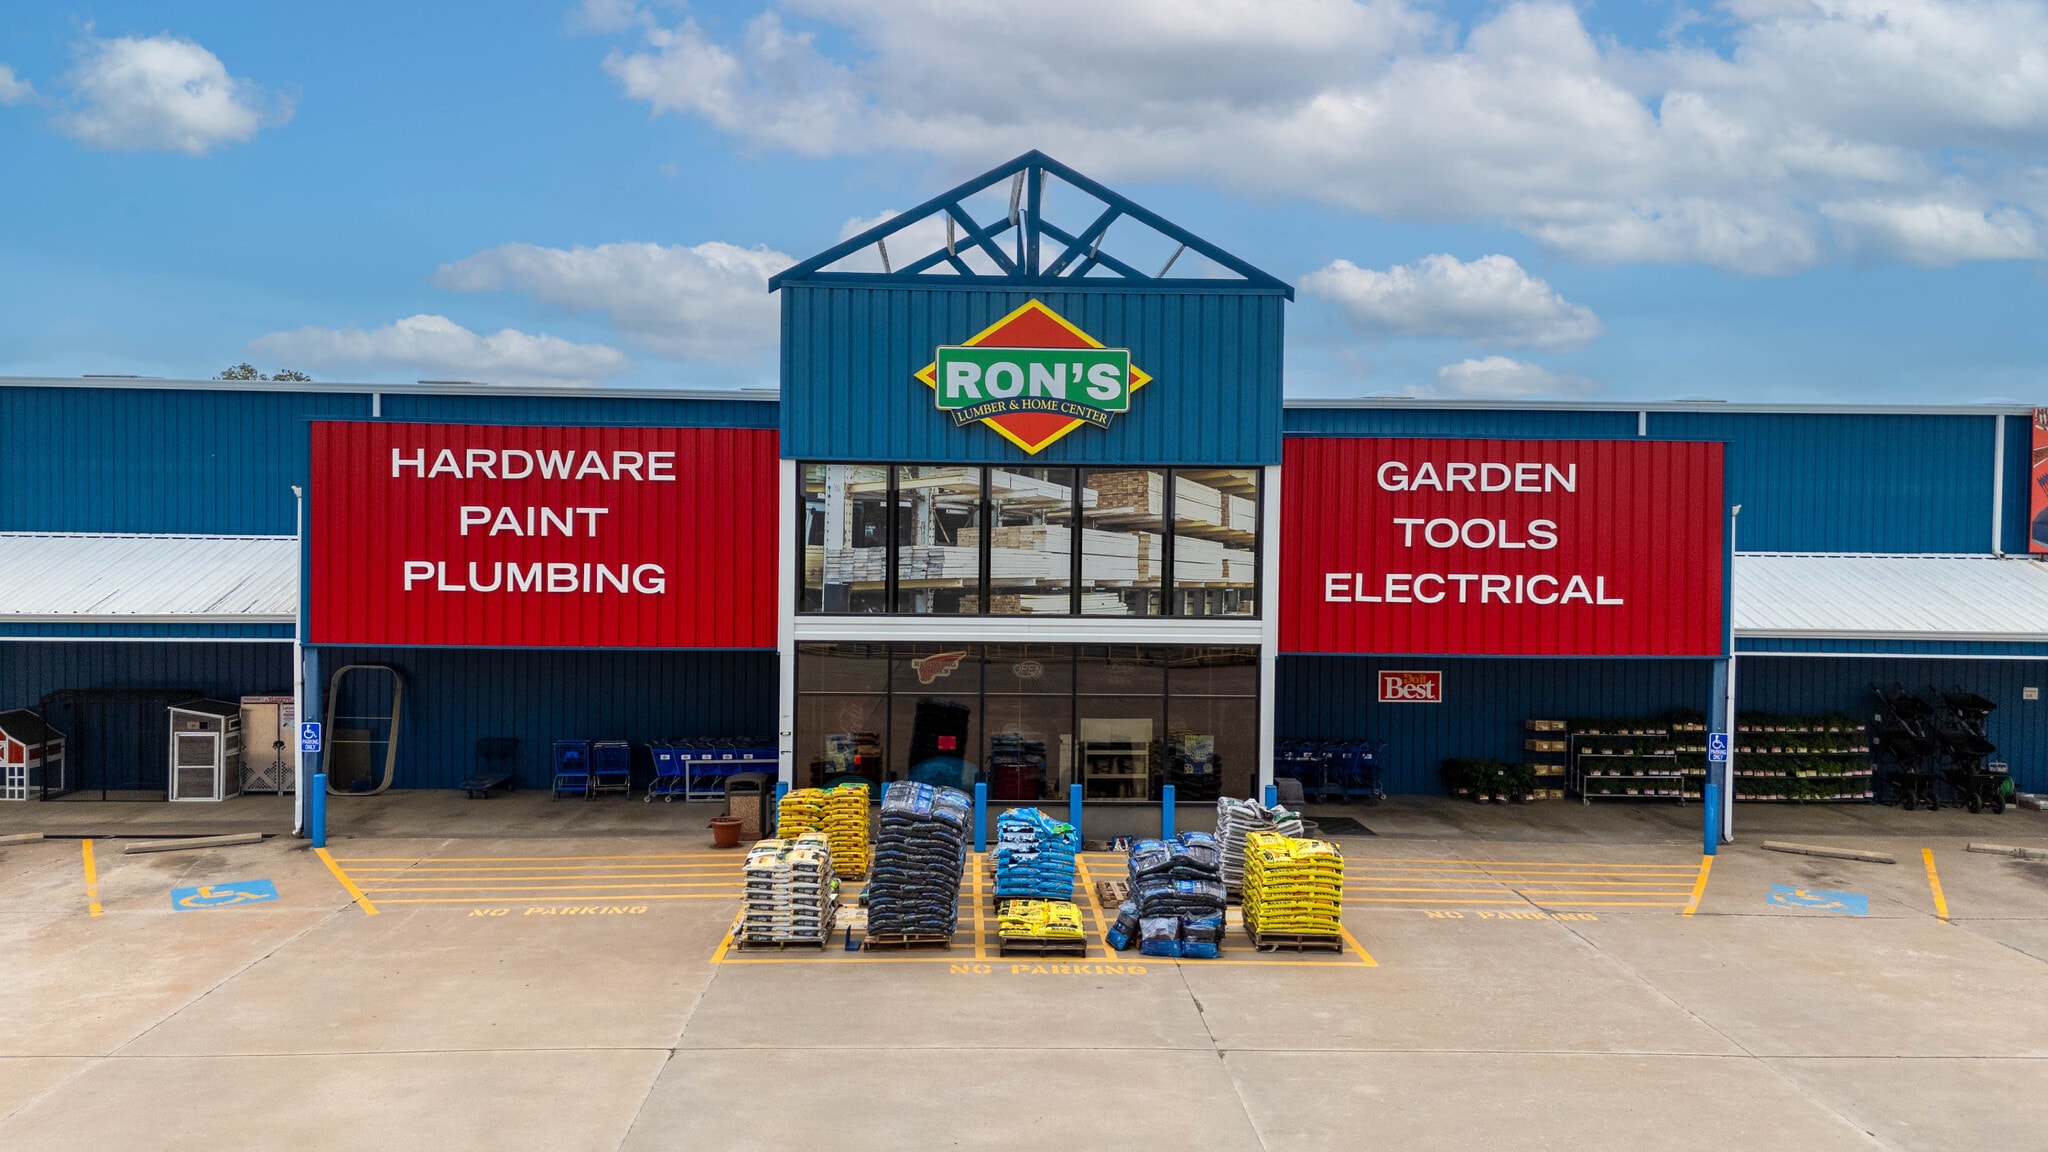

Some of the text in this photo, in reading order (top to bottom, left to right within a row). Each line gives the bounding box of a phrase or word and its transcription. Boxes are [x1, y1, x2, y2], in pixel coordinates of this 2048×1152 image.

[946, 361, 1121, 401] RON'S
[956, 398, 1108, 424] LUMBER & HOME CENTER
[391, 447, 676, 481] HARDWARE
[1376, 461, 1577, 493] GARDEN
[460, 506, 609, 537] PAINT
[1393, 517, 1558, 550] TOOLS
[403, 560, 666, 594] PLUMBING
[1324, 572, 1624, 605] ELECTRICAL
[1013, 663, 1043, 675] OPEN
[1384, 676, 1435, 699] Best
[467, 906, 648, 917] NO PARKING
[1424, 910, 1598, 922] NO PARKING
[949, 964, 1147, 976] NO PARKING
